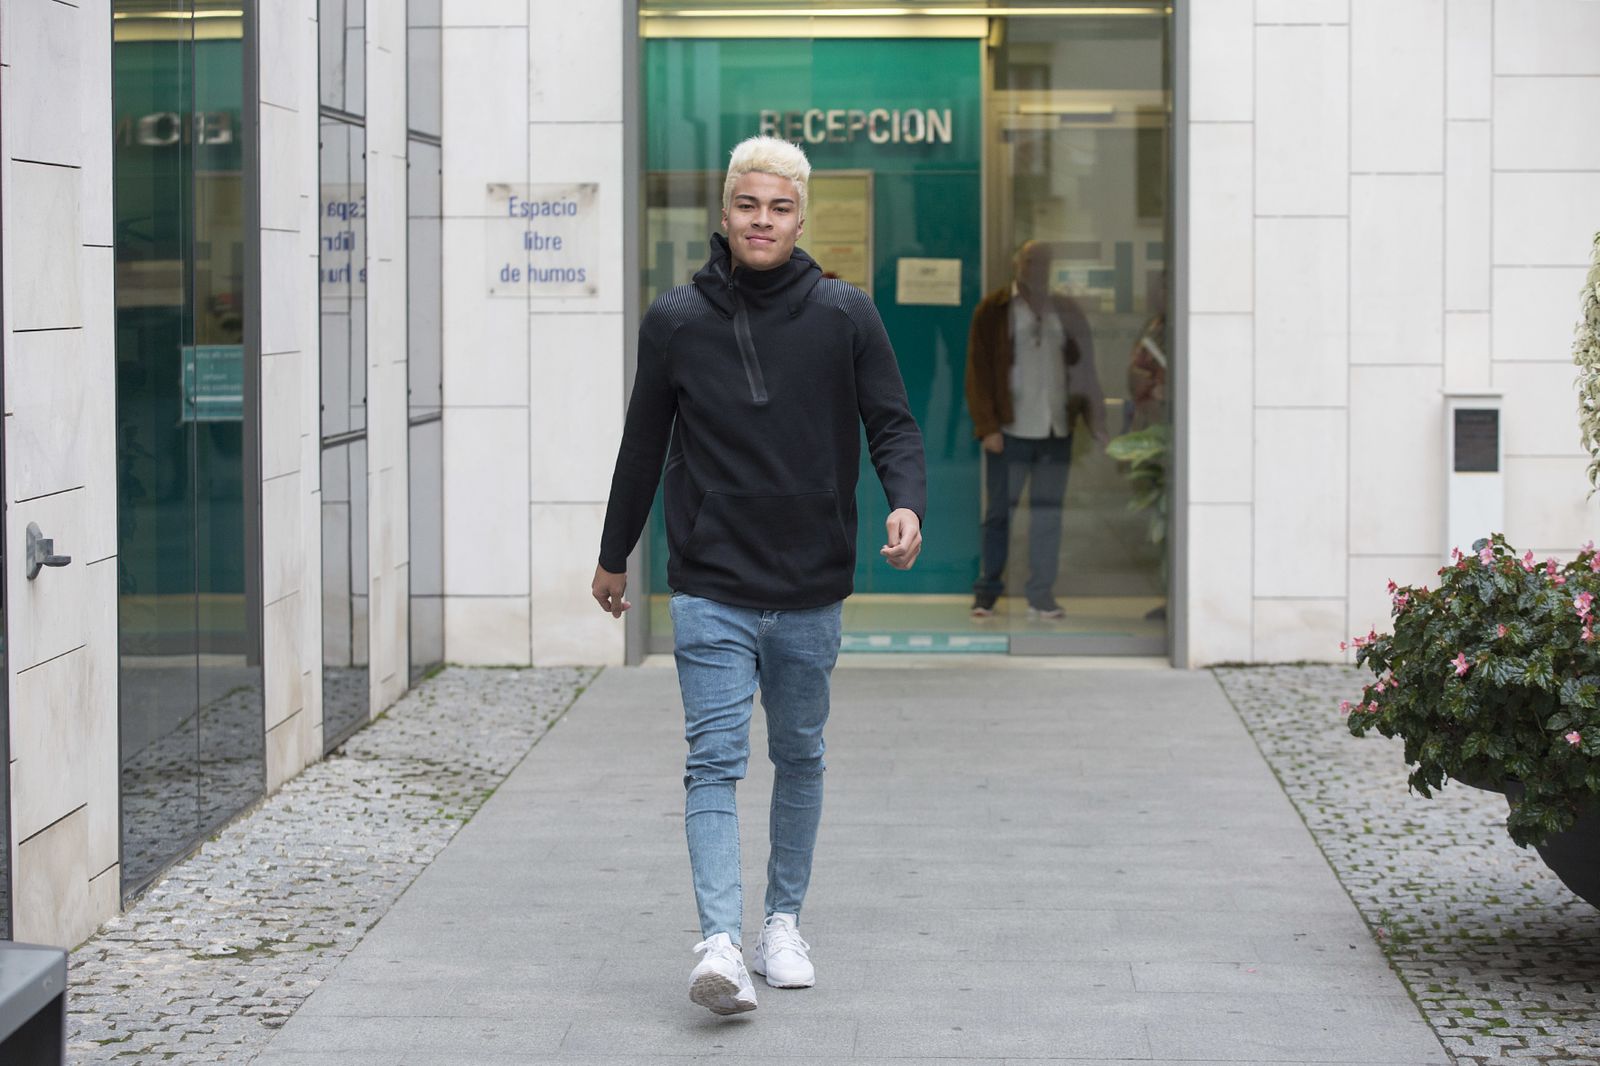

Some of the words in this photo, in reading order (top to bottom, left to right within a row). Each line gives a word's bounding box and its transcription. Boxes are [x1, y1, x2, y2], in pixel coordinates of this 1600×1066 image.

[759, 108, 953, 145] RECEPCION
[508, 195, 578, 221] Espacio
[524, 230, 563, 251] libre
[500, 262, 521, 282] de
[527, 262, 587, 282] humos
